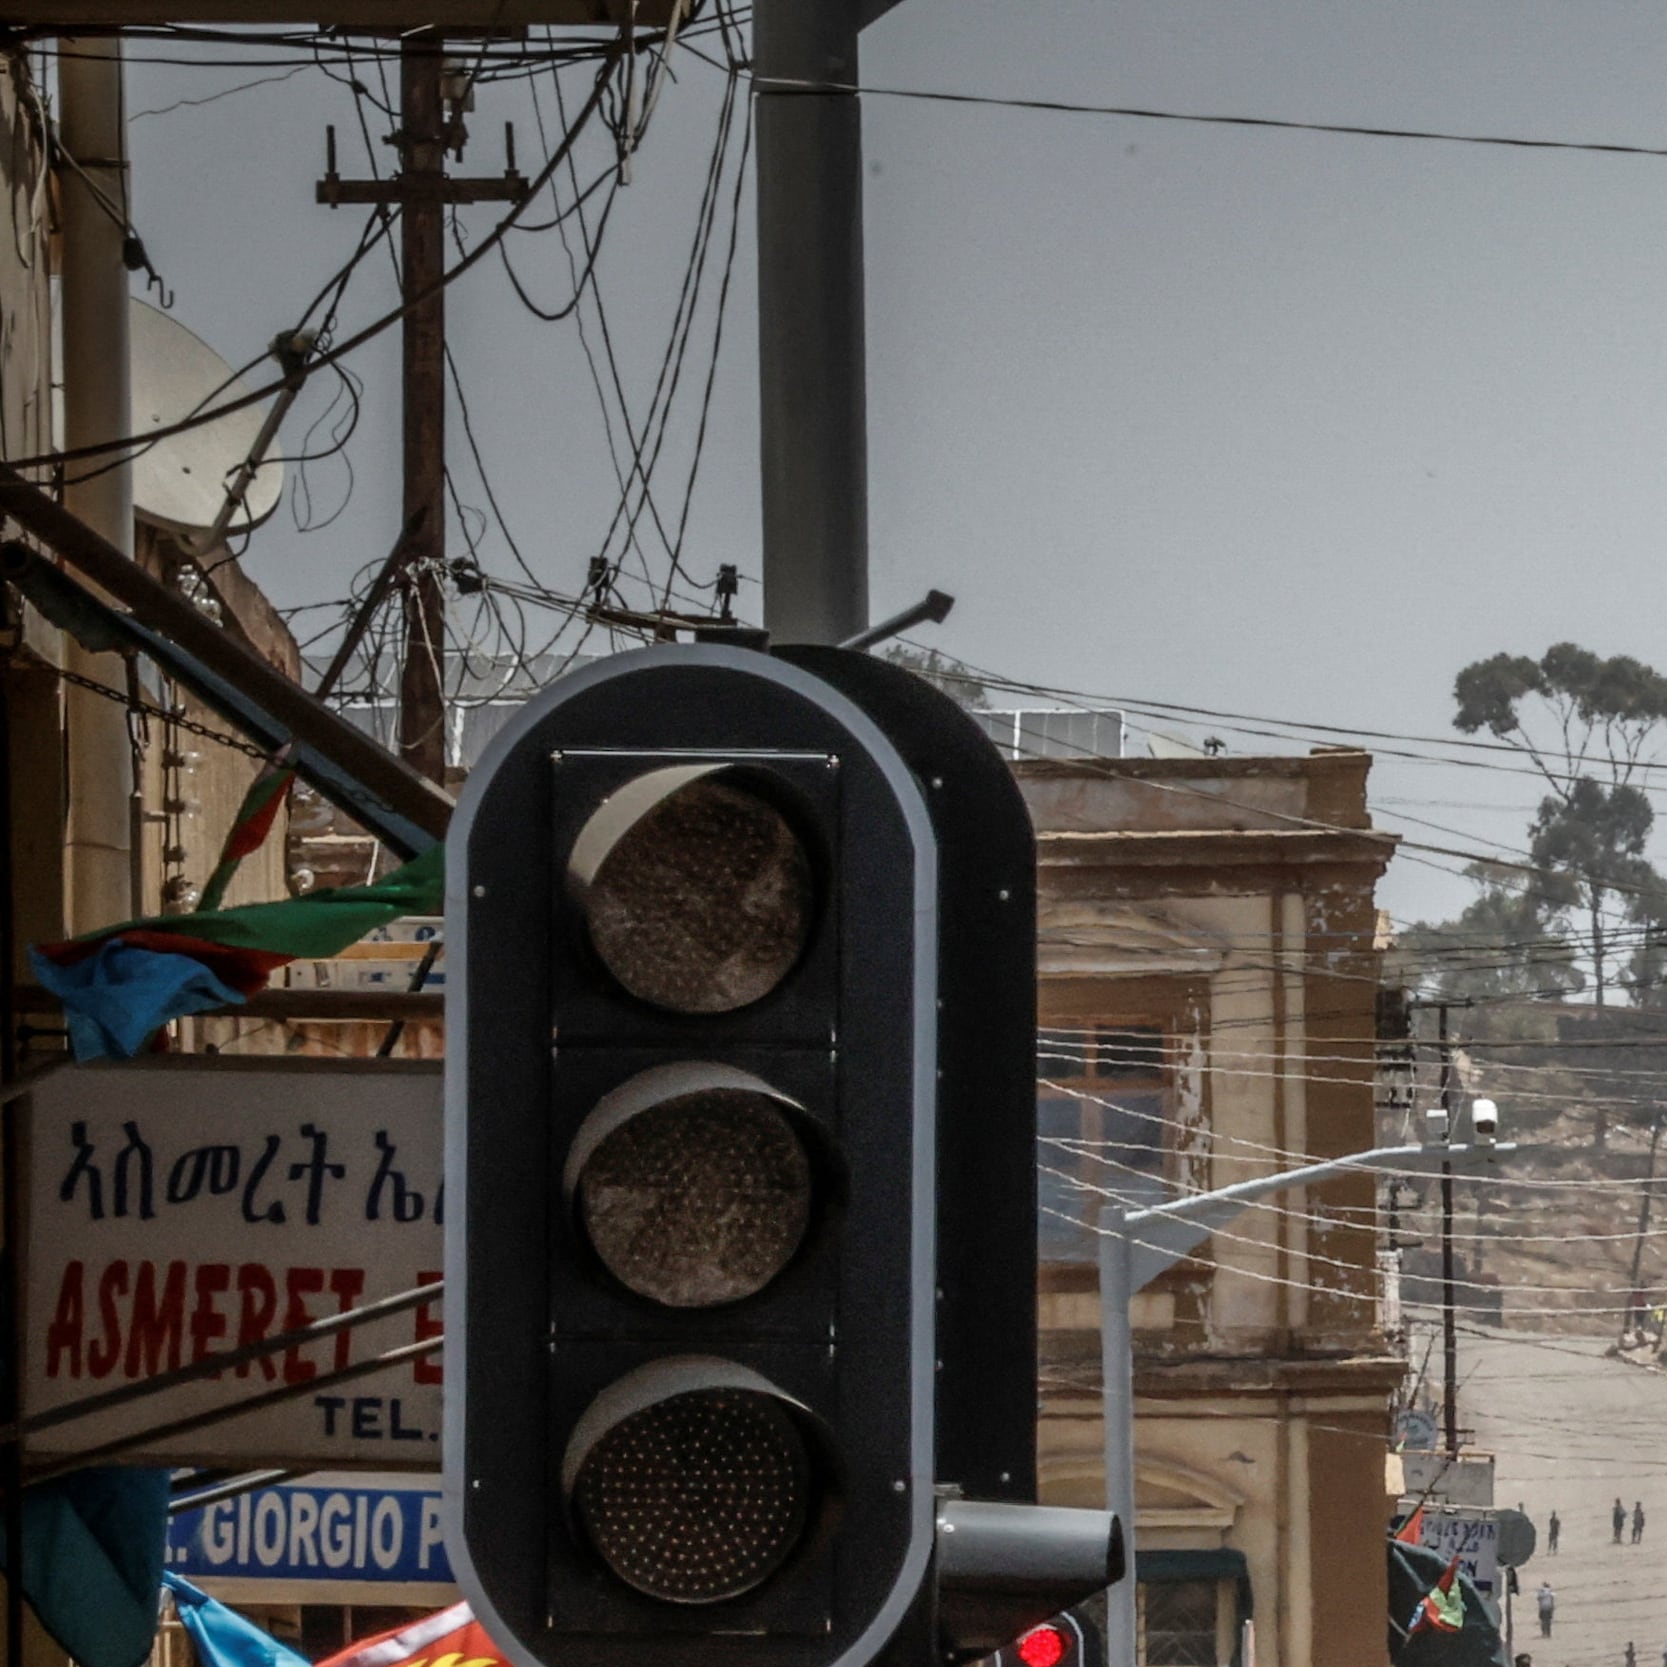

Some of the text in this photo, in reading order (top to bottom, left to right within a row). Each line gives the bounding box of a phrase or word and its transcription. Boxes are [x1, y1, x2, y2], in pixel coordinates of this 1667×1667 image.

[366, 1130, 444, 1226] ኤ
[47, 1260, 444, 1386] ASMERET E
[314, 1397, 440, 1441] TEL.
[202, 1491, 404, 1570] GIORGIO
[419, 1496, 445, 1570] P
